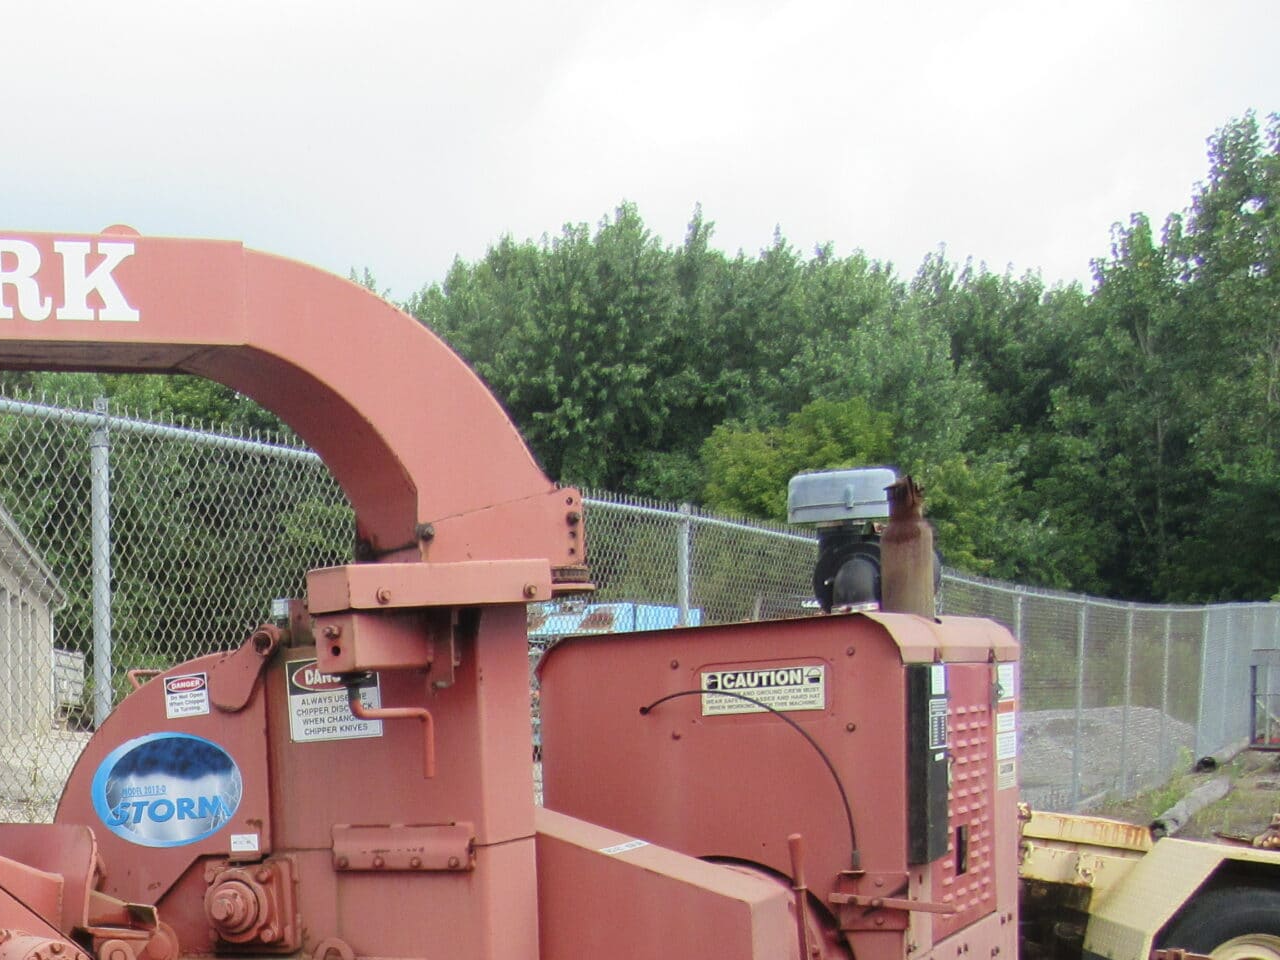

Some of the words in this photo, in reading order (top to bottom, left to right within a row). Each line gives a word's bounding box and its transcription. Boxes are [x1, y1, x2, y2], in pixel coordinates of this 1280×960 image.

[171, 680, 200, 690] DANGER
[722, 669, 802, 688] CAUTION
[301, 696, 333, 706] ALWAYS
[296, 706, 329, 717] CHIPPER
[331, 704, 349, 714] DISC
[302, 717, 325, 726] WHEN
[327, 714, 355, 724] CHANG
[304, 726, 337, 736] CHIPPER
[340, 722, 368, 732] KNIVES
[106, 795, 231, 827] STORM
